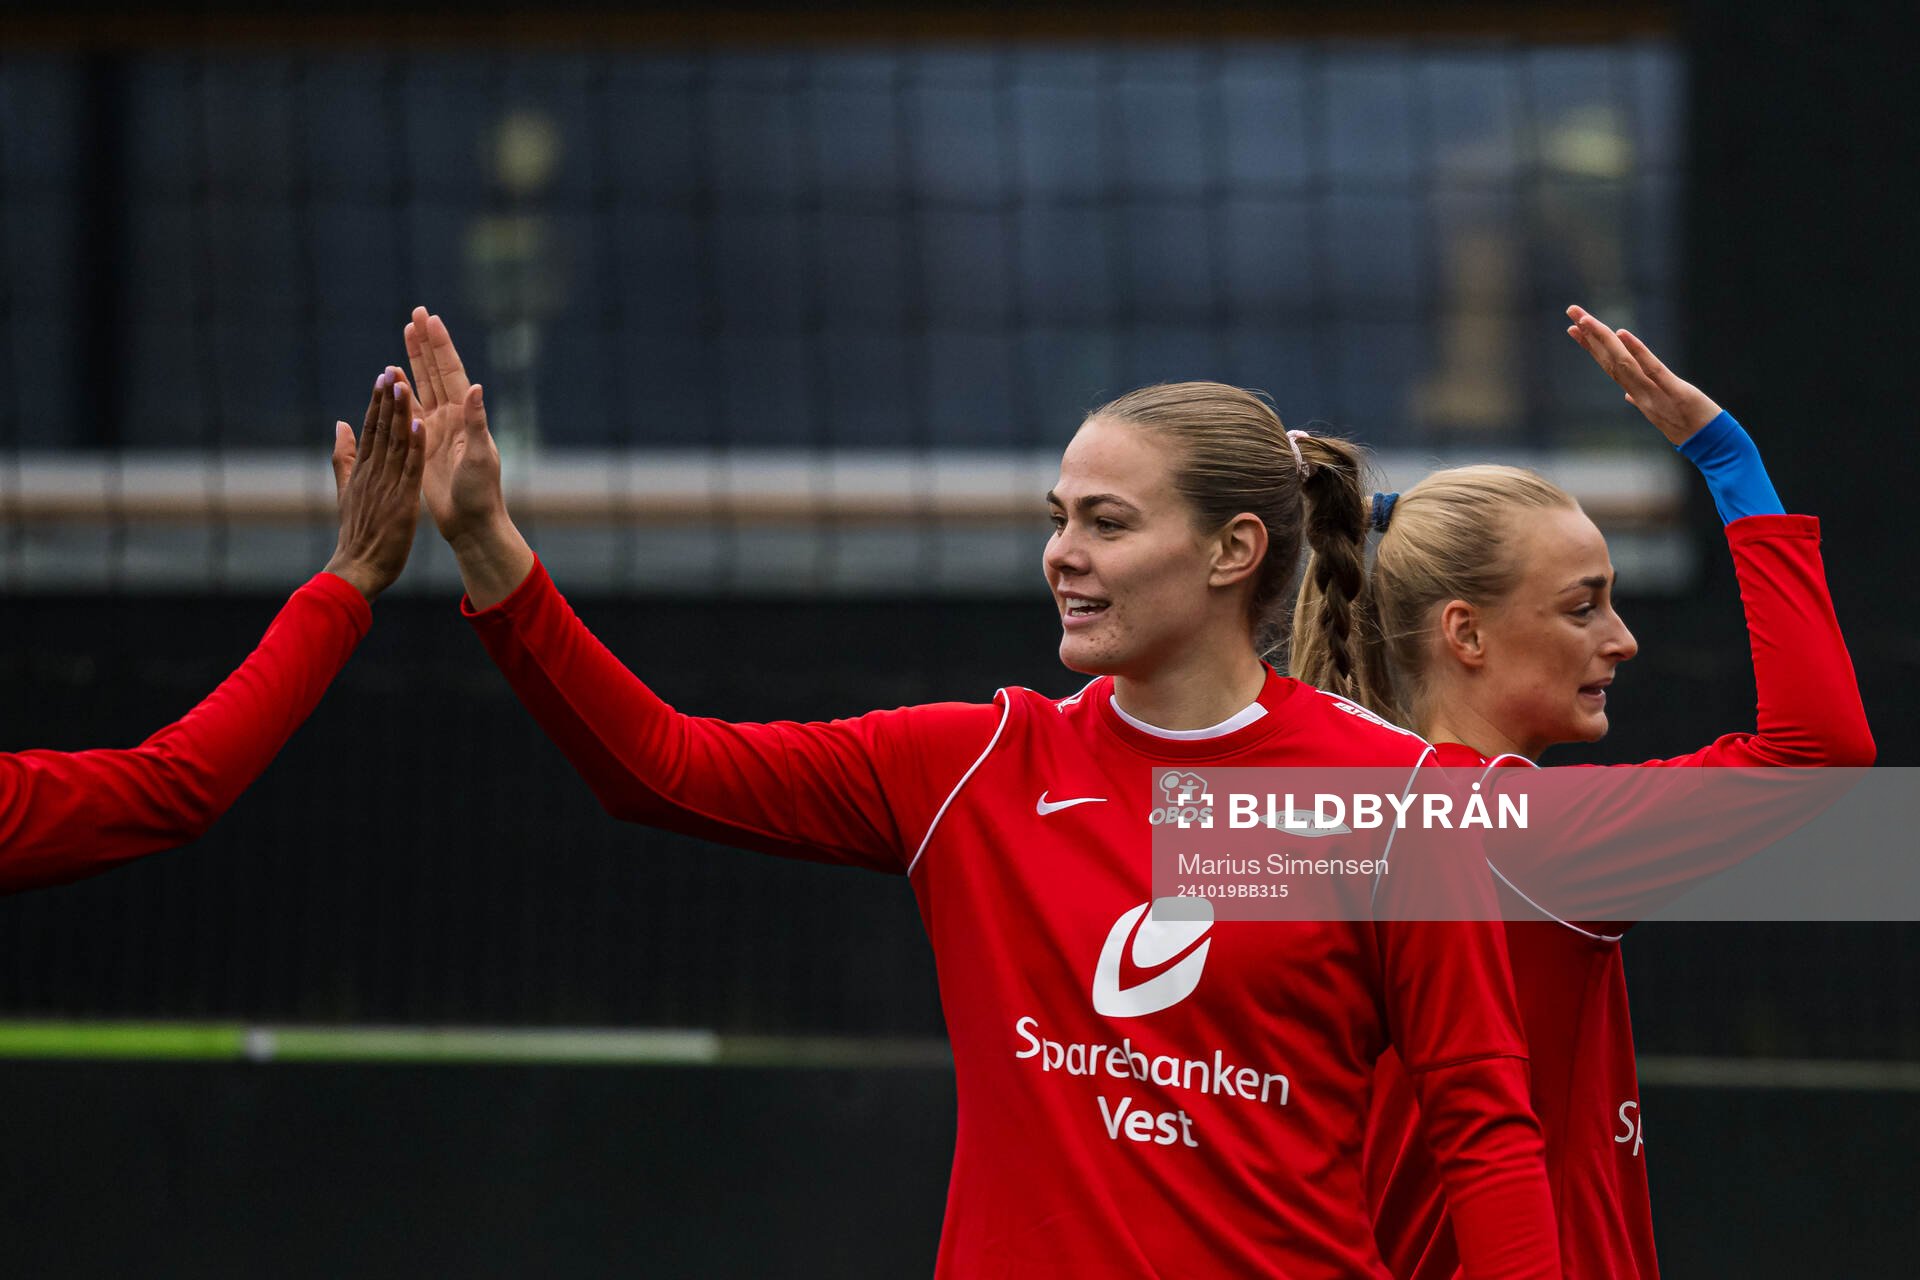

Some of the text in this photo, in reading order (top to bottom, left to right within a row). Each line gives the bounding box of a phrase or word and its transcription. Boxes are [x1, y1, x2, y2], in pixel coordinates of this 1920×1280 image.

[1148, 806, 1213, 826] OBOS
[1015, 1015, 1290, 1106] Sparebanken
[1096, 1094, 1200, 1148] Vest
